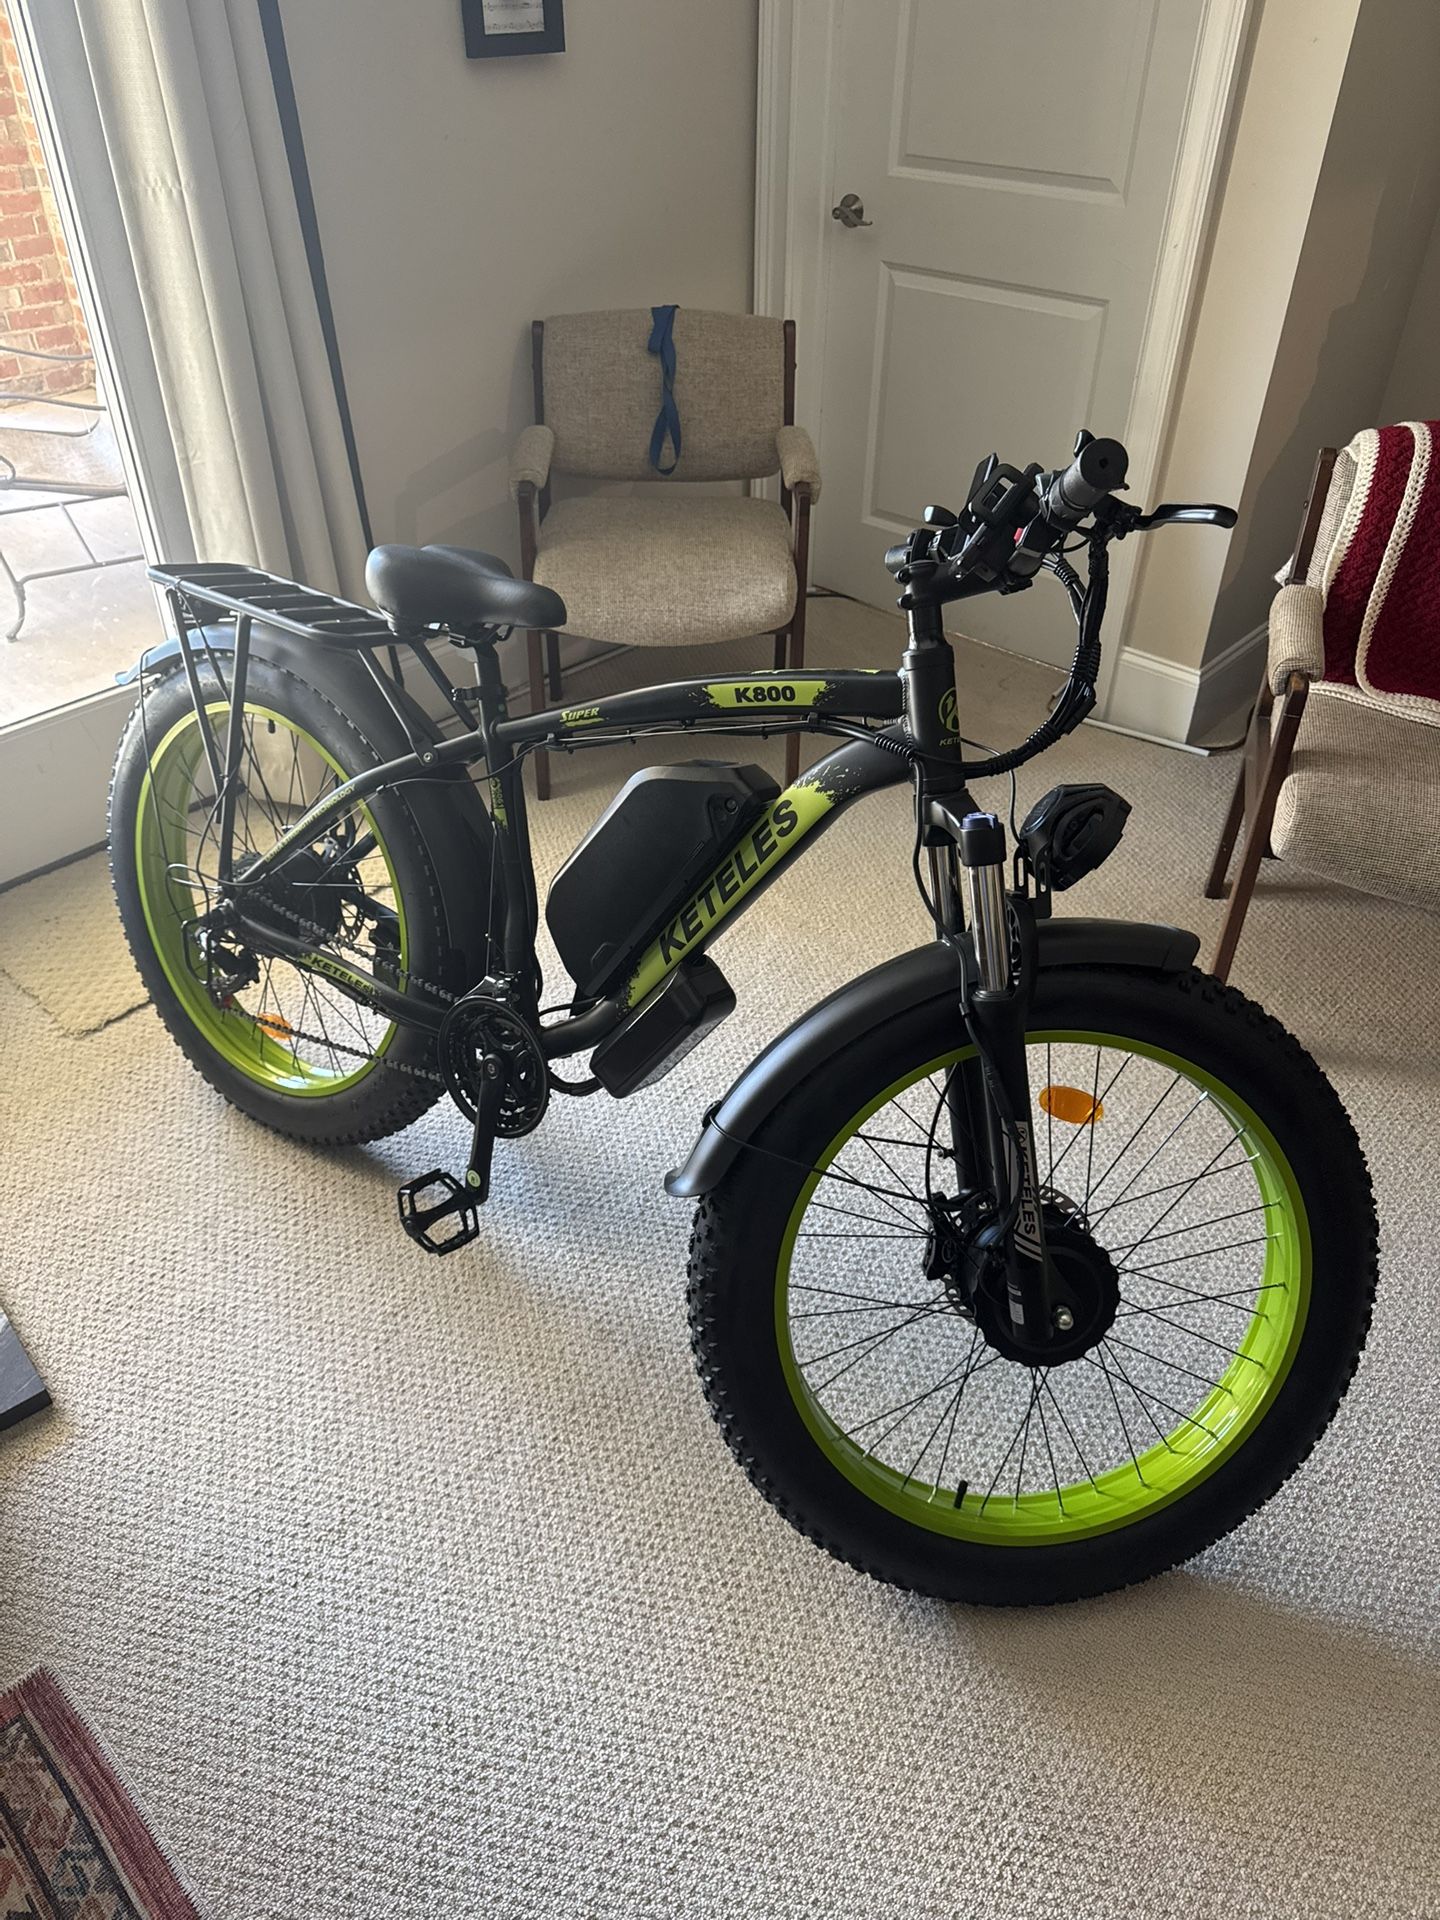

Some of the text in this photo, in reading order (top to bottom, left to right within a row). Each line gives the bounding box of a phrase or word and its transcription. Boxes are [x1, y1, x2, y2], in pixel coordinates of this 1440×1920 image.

[734, 686, 796, 703] K800
[560, 707, 600, 722] SUPER
[659, 799, 798, 965] KETELES
[311, 956, 373, 993] KETELES
